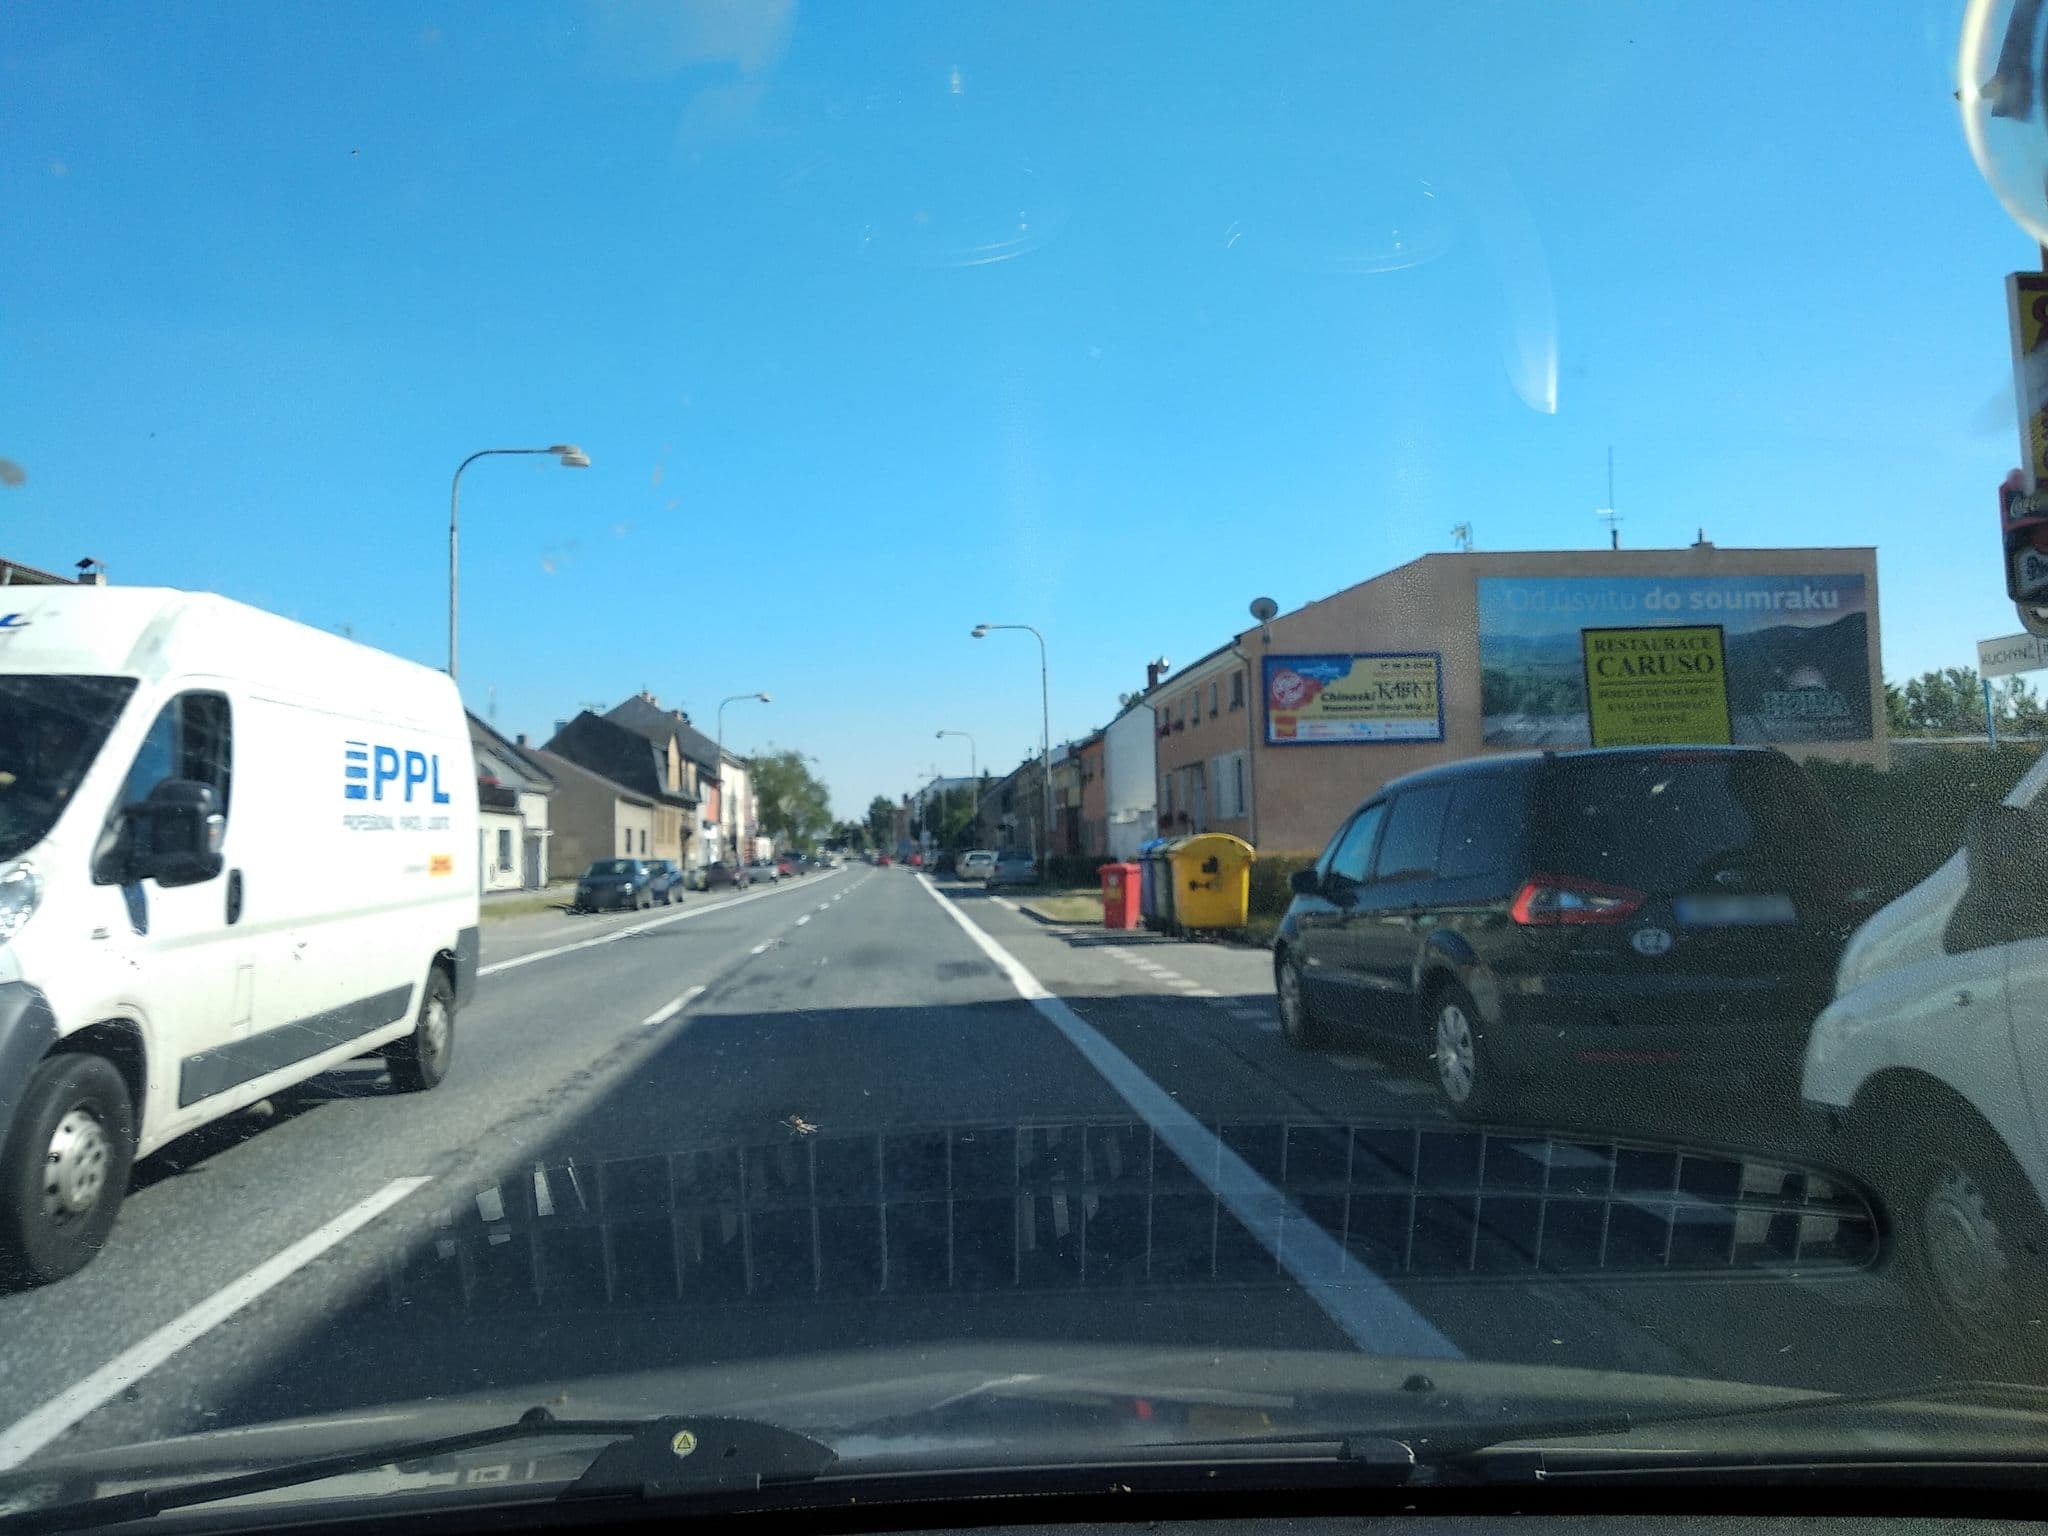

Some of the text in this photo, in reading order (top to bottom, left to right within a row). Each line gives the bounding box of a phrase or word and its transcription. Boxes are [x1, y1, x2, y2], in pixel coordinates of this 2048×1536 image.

[1644, 586, 1681, 609] do
[1688, 584, 1839, 609] soumraku
[1594, 636, 1711, 651] RESTAURACE
[1596, 652, 1715, 677] CARUSO
[373, 744, 450, 804] PPL
